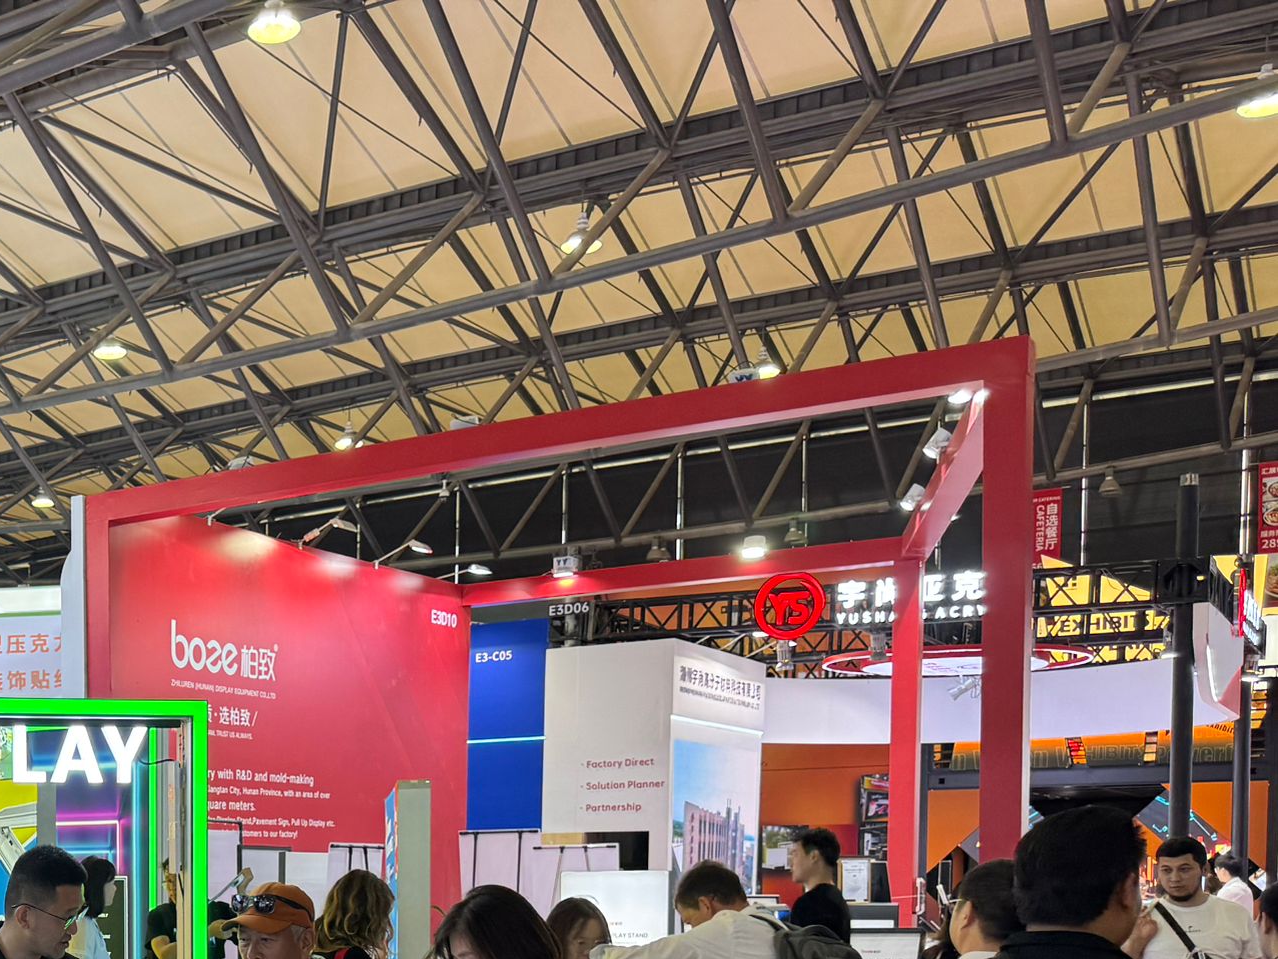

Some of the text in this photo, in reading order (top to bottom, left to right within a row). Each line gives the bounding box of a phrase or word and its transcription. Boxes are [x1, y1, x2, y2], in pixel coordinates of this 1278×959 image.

[1036, 504, 1044, 552] CAFETERIA
[1045, 503, 1058, 550] 自选餐厅
[548, 601, 590, 617] E3D06
[431, 609, 458, 628] E3D10
[240, 645, 276, 681] 柏致
[475, 650, 513, 663] E3-C05
[586, 757, 655, 769] Factory Direct
[217, 769, 234, 780] with
[236, 769, 252, 780] R&D
[254, 772, 268, 782] and
[269, 772, 314, 787] mold-making
[586, 780, 665, 790] Solution Planner
[229, 801, 256, 811] meters.
[585, 802, 642, 813] Partnership
